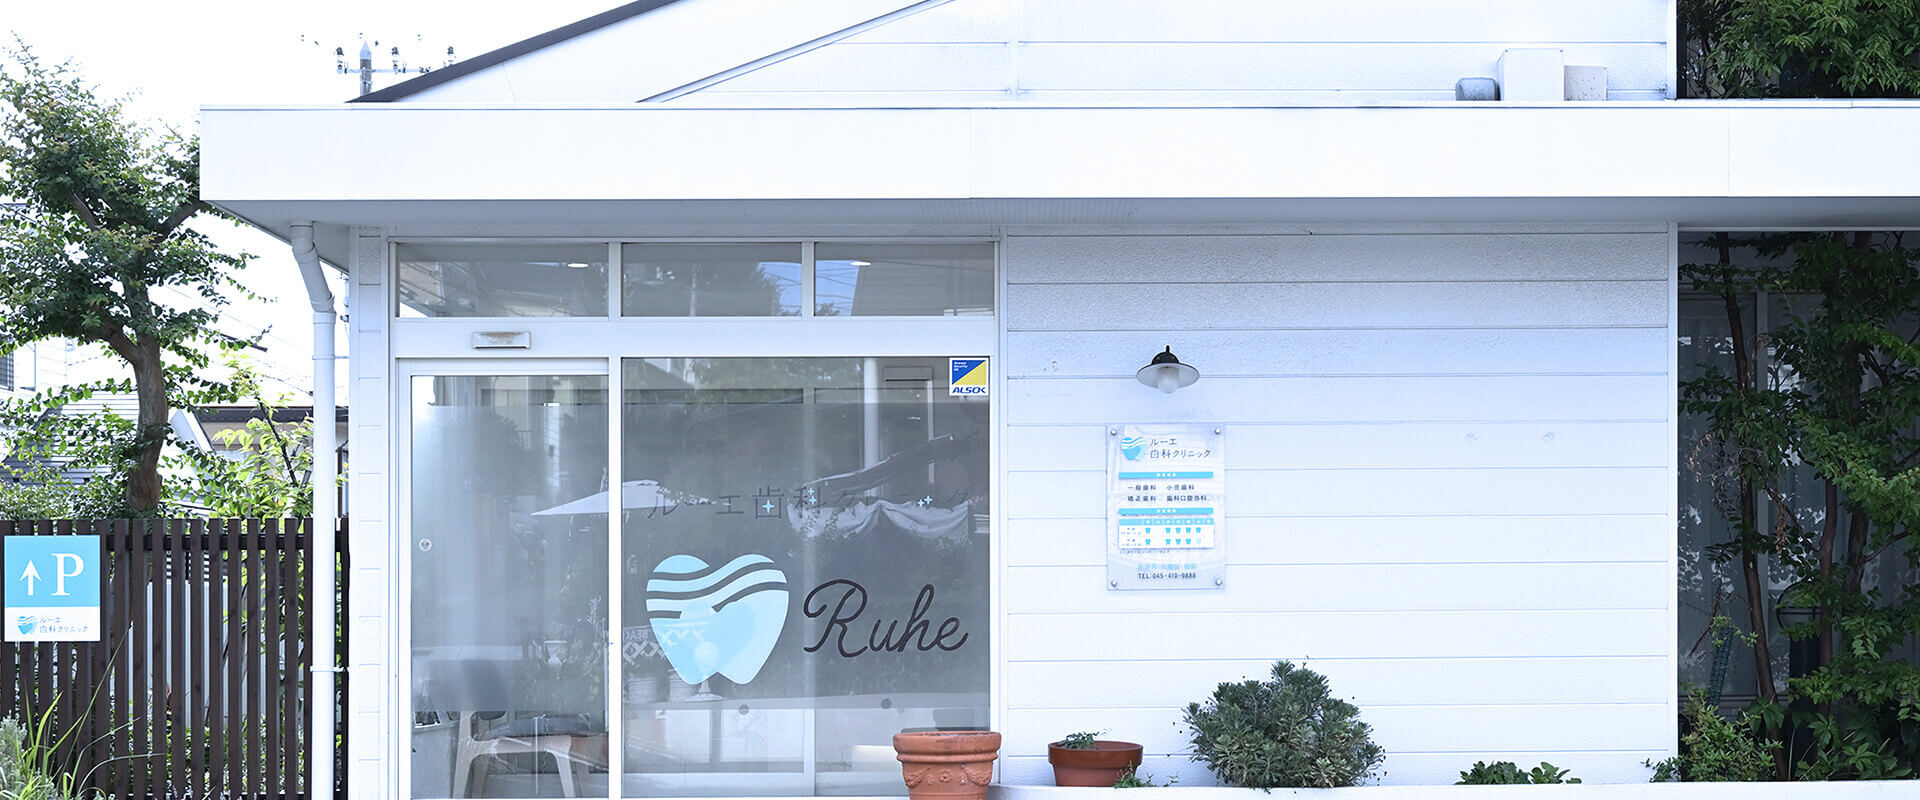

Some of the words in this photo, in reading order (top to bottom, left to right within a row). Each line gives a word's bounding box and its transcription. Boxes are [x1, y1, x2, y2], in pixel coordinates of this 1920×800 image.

[1150, 438, 1177, 446] ルーエ
[1150, 449, 1211, 459] 歯科クリニック
[51, 553, 84, 596] P
[803, 579, 968, 658] Ruhe
